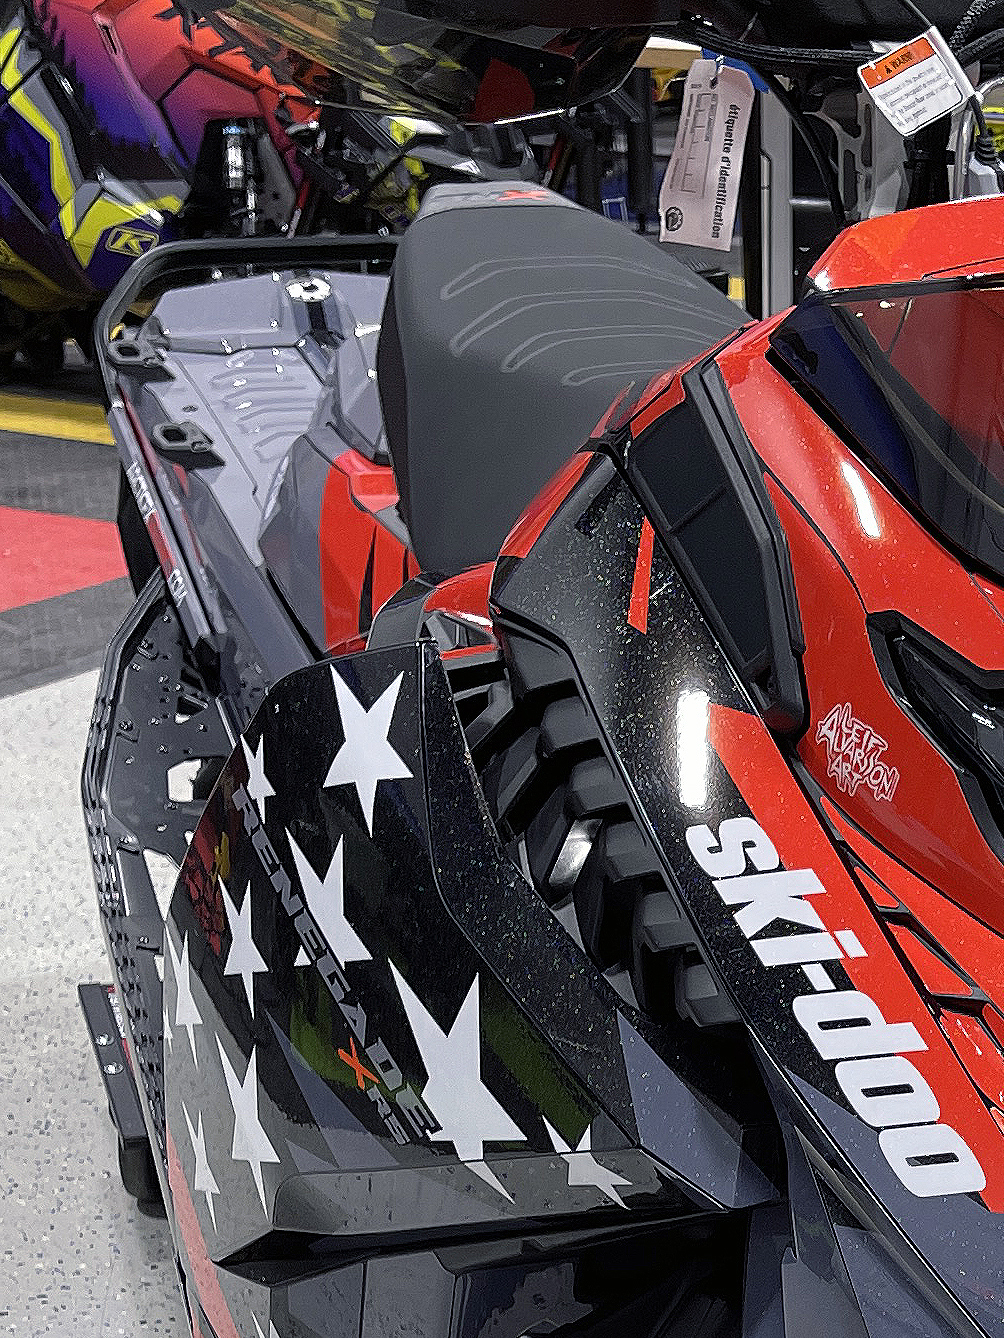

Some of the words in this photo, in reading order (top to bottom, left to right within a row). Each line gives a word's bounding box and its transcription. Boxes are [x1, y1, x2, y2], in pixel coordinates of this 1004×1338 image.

[711, 156, 732, 239] d'identification
[723, 104, 741, 153] étiquette
[232, 783, 443, 1138] RENEGADE
[685, 817, 987, 1198] ski-doo
